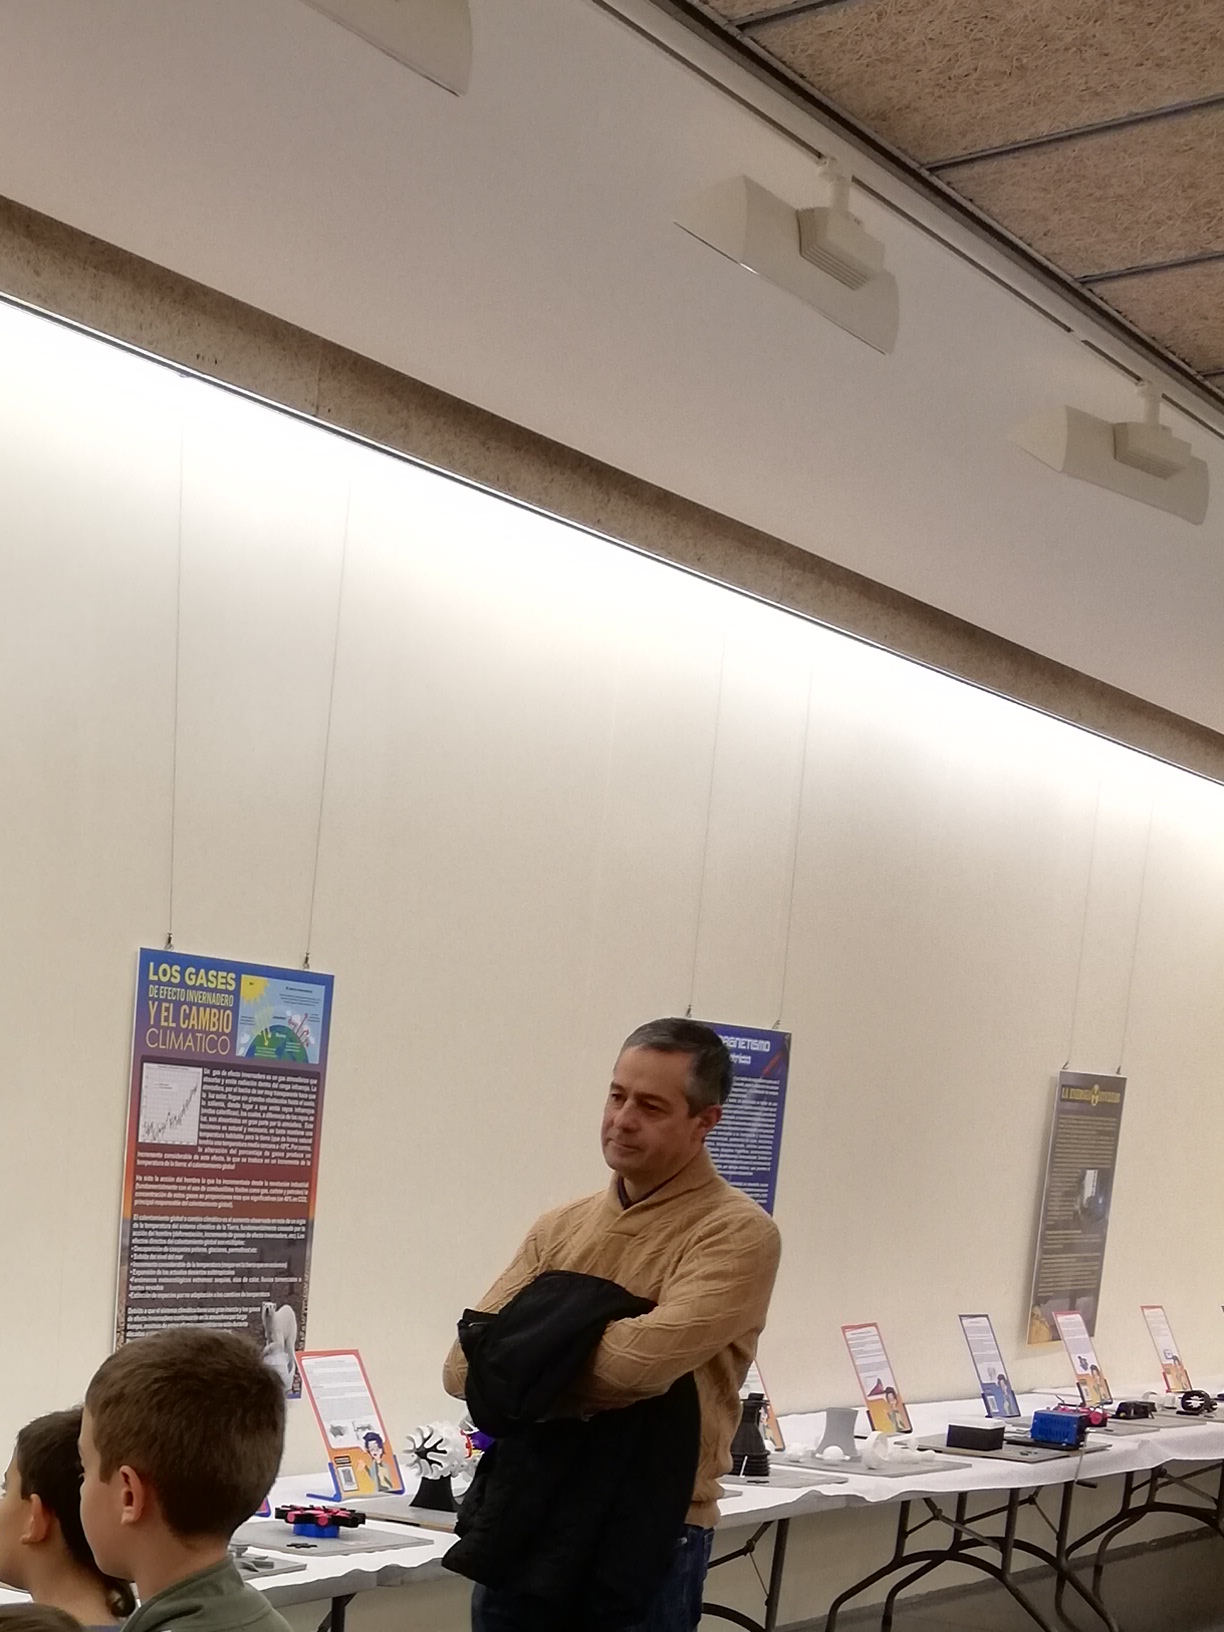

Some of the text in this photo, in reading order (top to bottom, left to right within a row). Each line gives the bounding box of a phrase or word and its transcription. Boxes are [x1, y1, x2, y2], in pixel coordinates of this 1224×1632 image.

[148, 962, 236, 991] LOS GASES
[148, 984, 234, 1007] DE EFECTO INVERNADERO
[148, 1001, 158, 1025] Y
[161, 1002, 175, 1027] EL
[180, 1004, 233, 1034] CAMBIO
[146, 1027, 231, 1055] CLIMATICO
[719, 1035, 771, 1052] AGNETISMO
